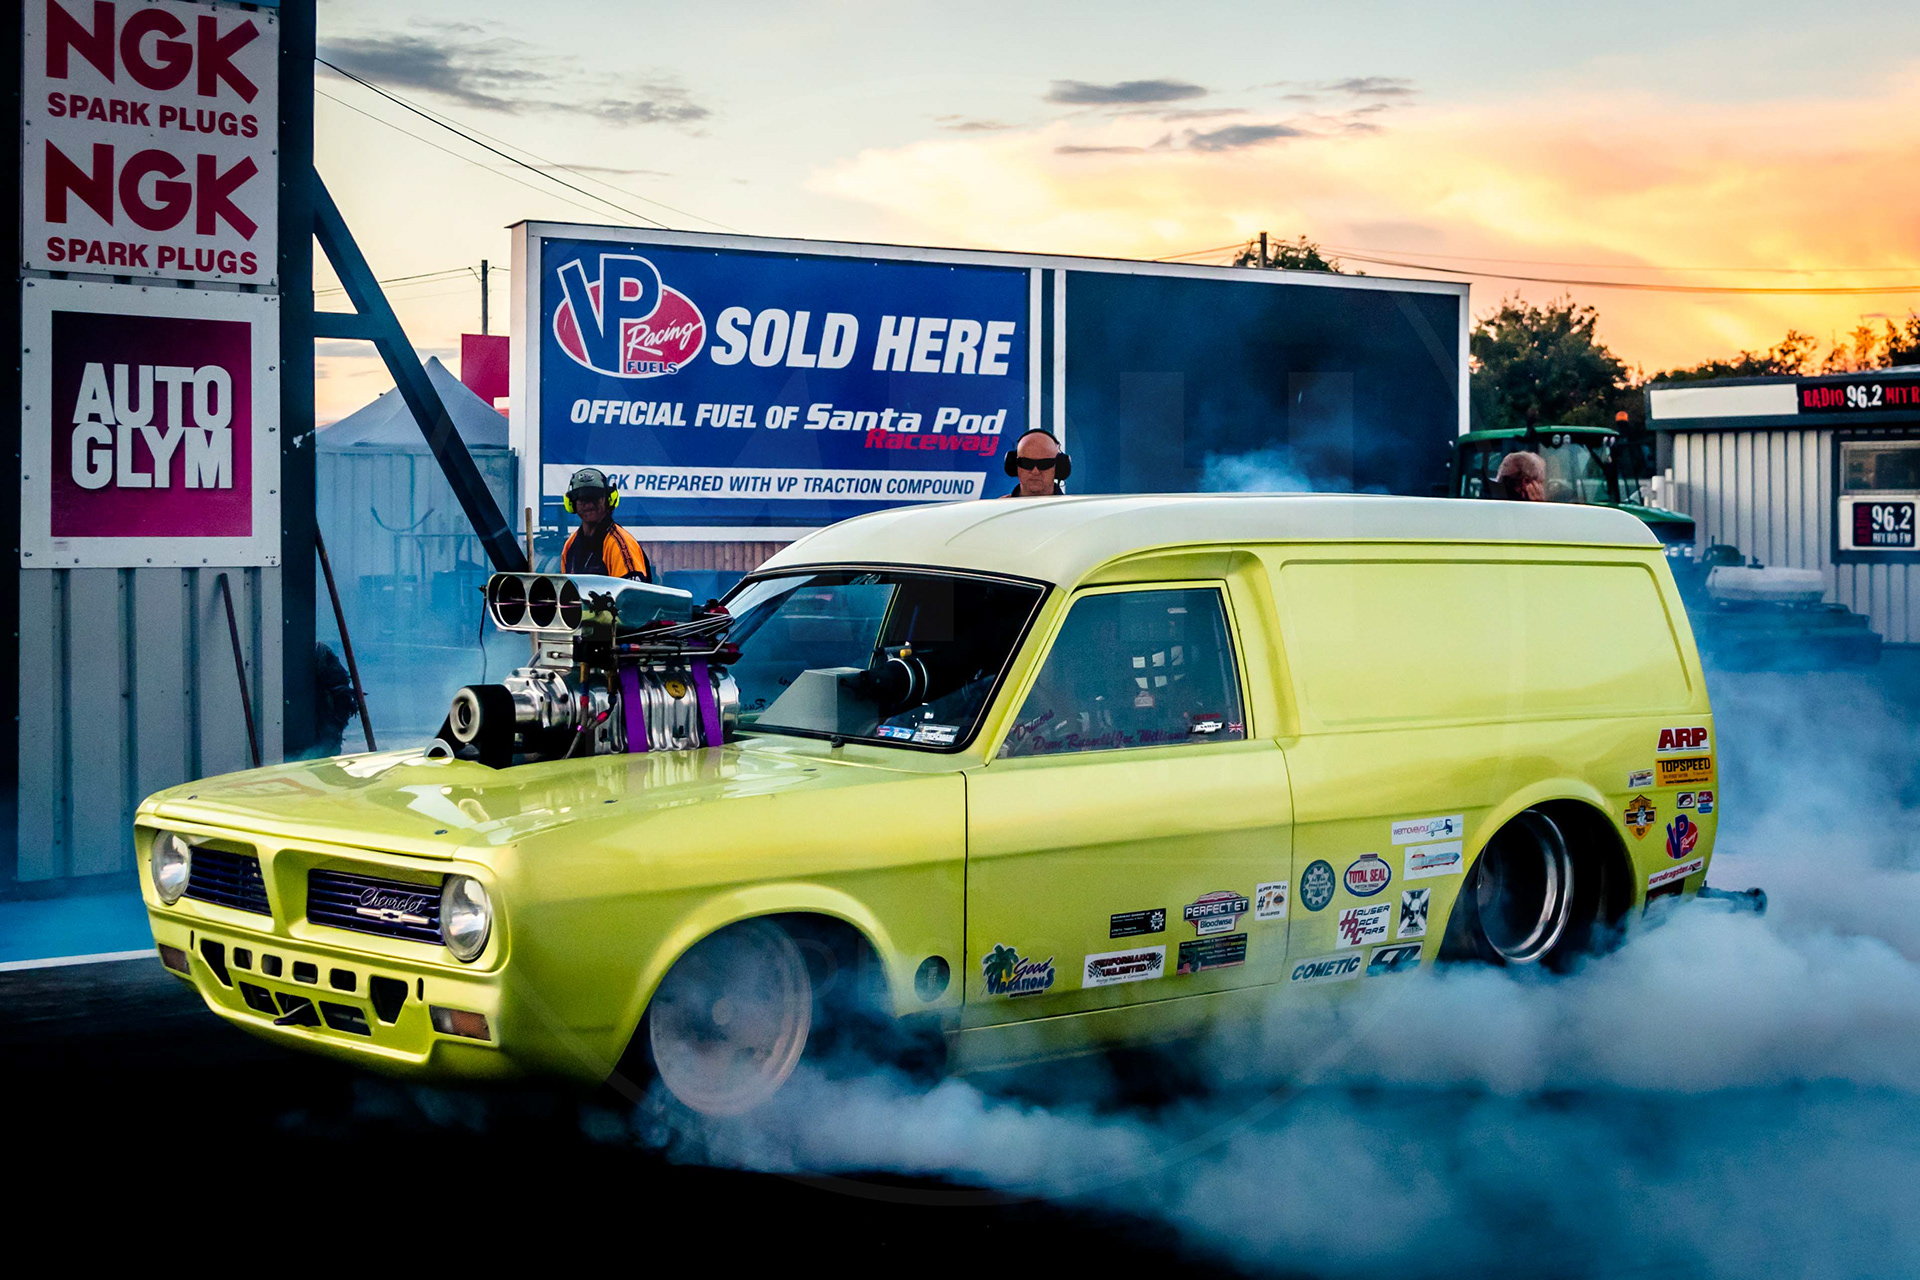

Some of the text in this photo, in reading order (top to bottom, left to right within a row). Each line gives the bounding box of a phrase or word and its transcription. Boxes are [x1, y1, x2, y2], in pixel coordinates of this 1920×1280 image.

[46, 0, 260, 104] NGK
[47, 92, 259, 138] SPARK PLUGS
[45, 138, 259, 242] NGK
[47, 236, 258, 275] SPARK PLUGS
[556, 253, 662, 376] VP
[626, 319, 702, 360] Racing
[710, 306, 1016, 375] SOLD HERE
[626, 361, 679, 375] FUELS
[72, 362, 232, 431] AUTO
[1803, 387, 1845, 408] RADIO
[1846, 384, 1883, 408] 96.2
[570, 398, 1007, 435] OFFICIAL FUEL OF Santa Pod
[71, 421, 233, 489] GLYM
[864, 428, 999, 457] Raceway
[634, 474, 723, 492] PREPARED
[729, 476, 771, 492] WITH
[777, 476, 798, 493] VP
[803, 477, 882, 494] TRACTION
[886, 478, 975, 494] COMPOUND
[1872, 505, 1912, 531] 96.2
[1657, 727, 1707, 748] ARP
[1657, 757, 1711, 773] TOPSPEED
[1666, 813, 1689, 859] VP
[1349, 868, 1387, 884] TOTAL SEAL
[359, 887, 428, 914] Chevrolet
[1186, 900, 1248, 918] PERFECT ET
[1200, 918, 1232, 928] Bloodwise
[1340, 904, 1390, 932] HAUSER
[1012, 957, 1053, 985] Good
[1101, 964, 1147, 977] UNLIMITED
[1292, 957, 1361, 981] COMETIC
